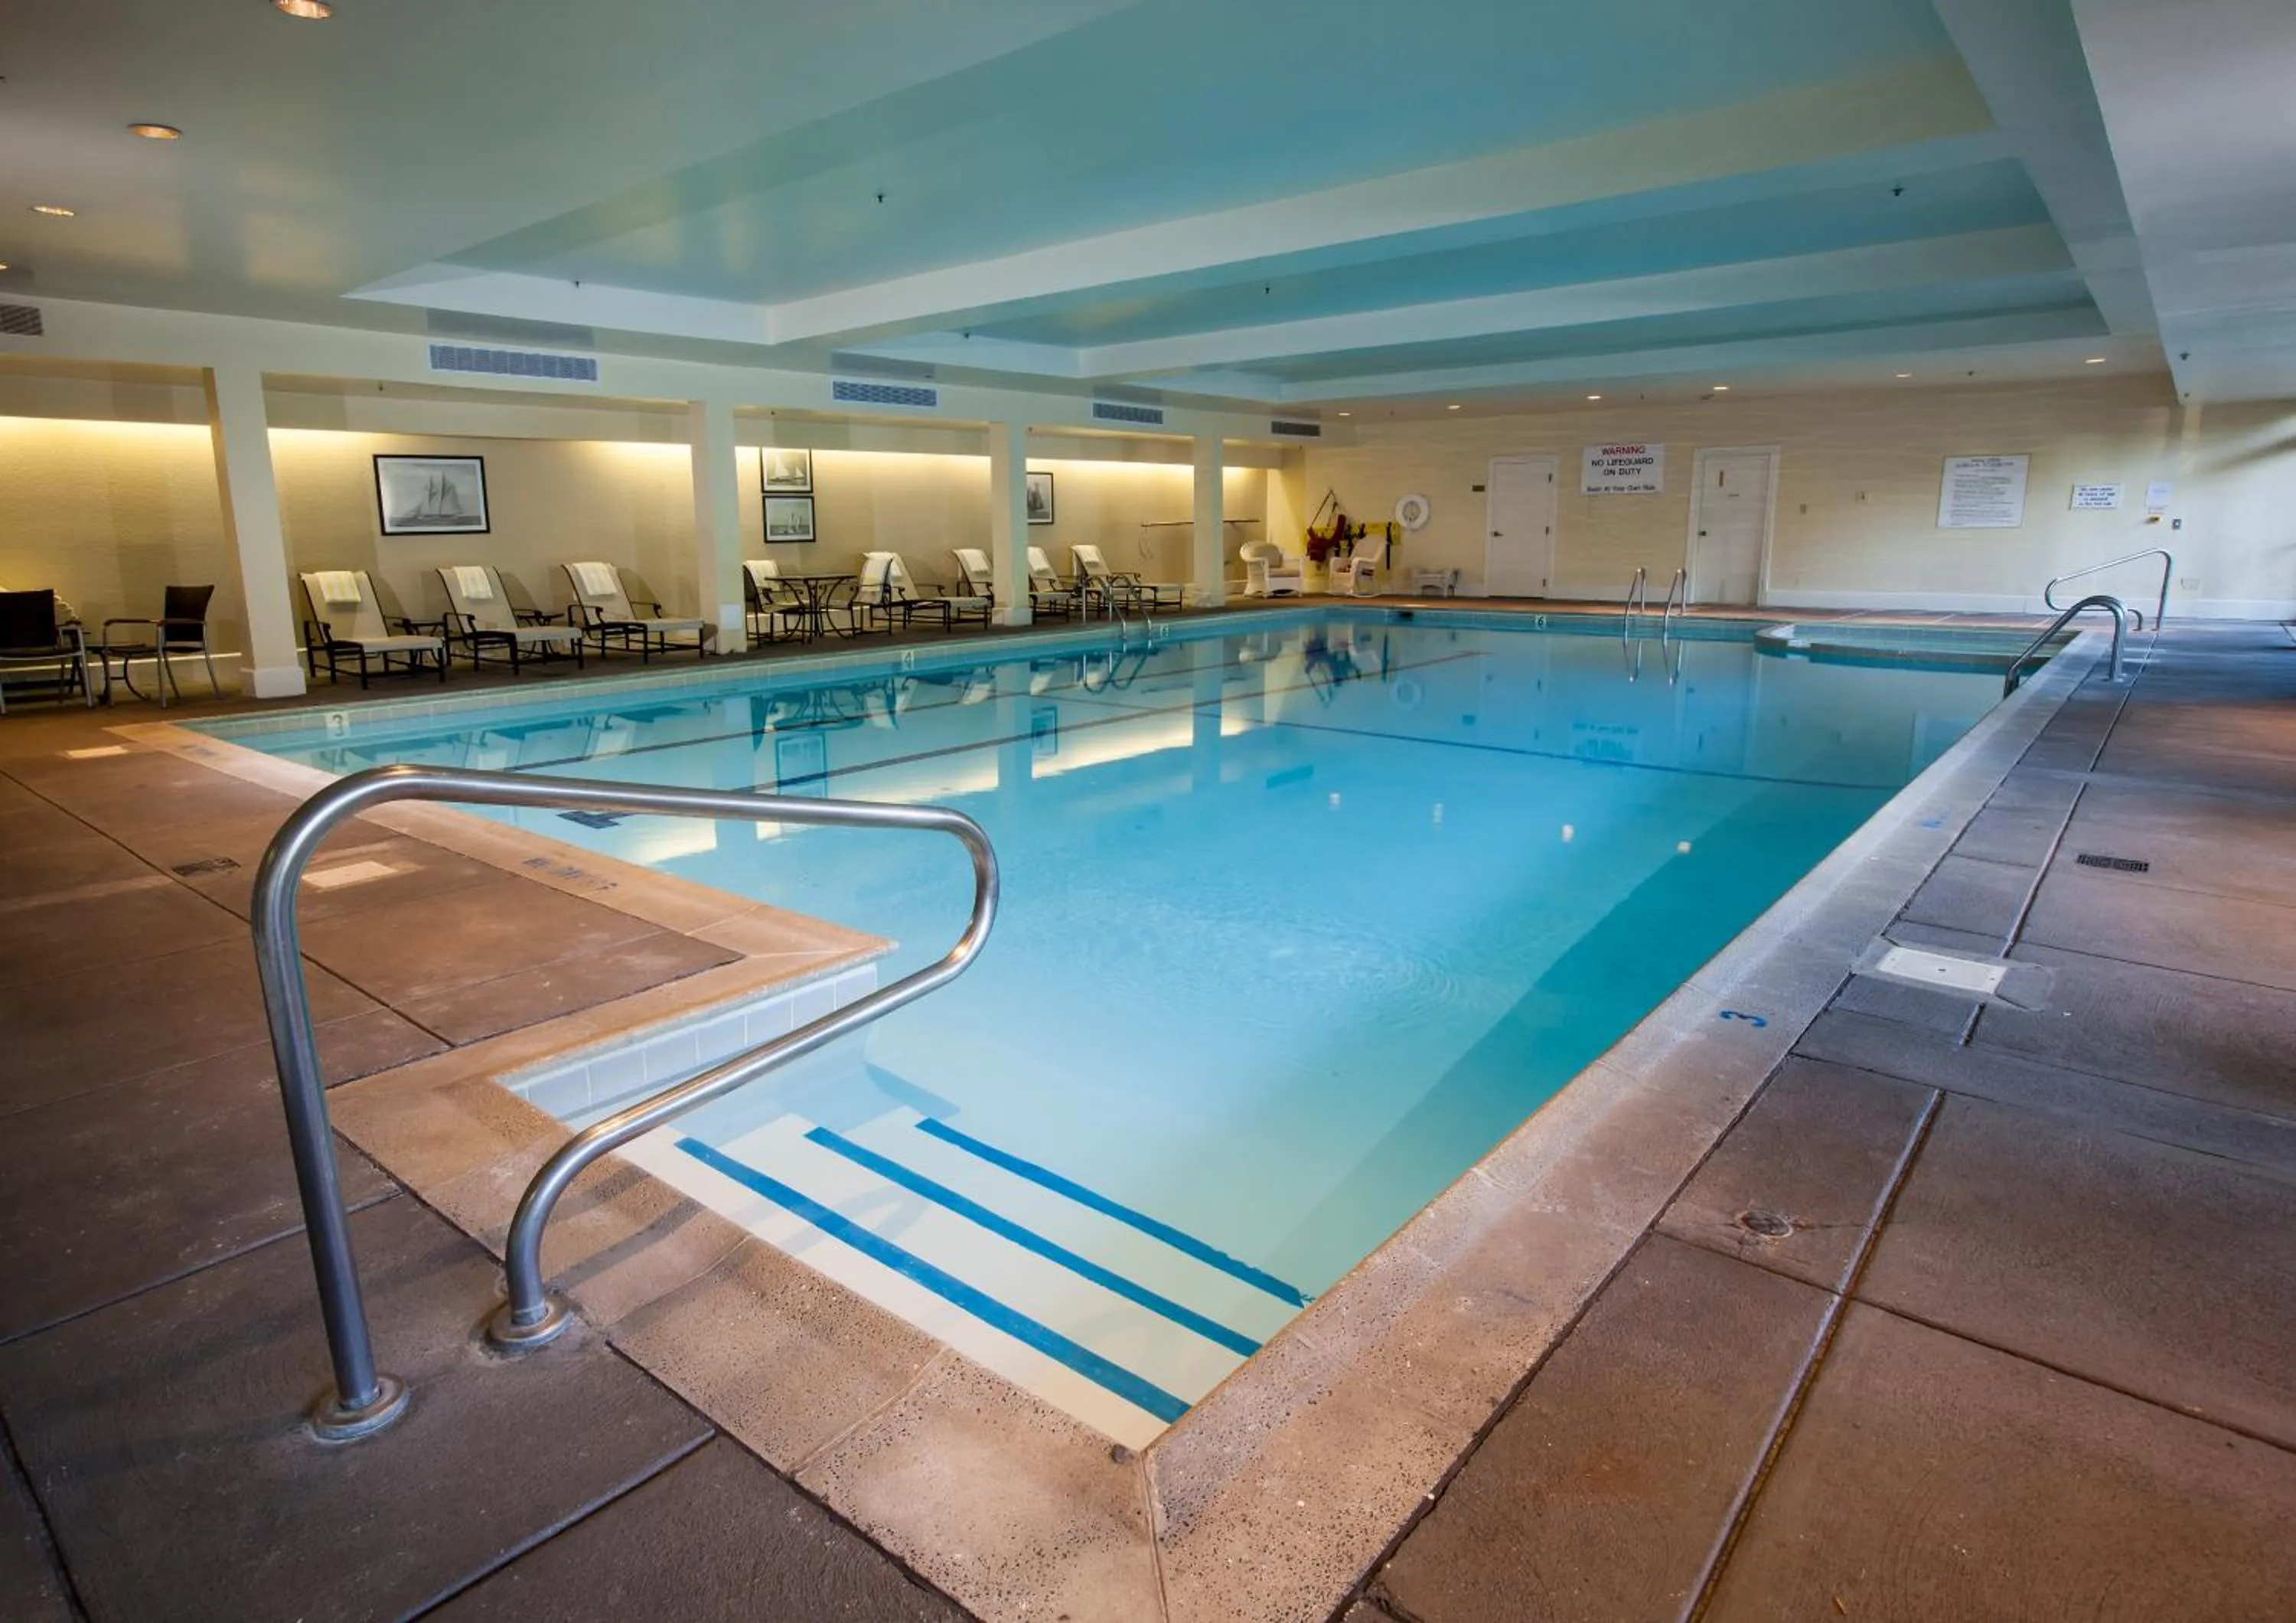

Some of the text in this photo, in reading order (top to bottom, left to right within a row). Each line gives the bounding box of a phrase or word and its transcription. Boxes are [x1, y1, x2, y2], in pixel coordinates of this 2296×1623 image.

[1601, 445, 1645, 456] WARNING
[1606, 457, 1654, 466] LIFEGUARD
[1619, 467, 1642, 475] DUTY
[1718, 1010, 1768, 1028] 3
